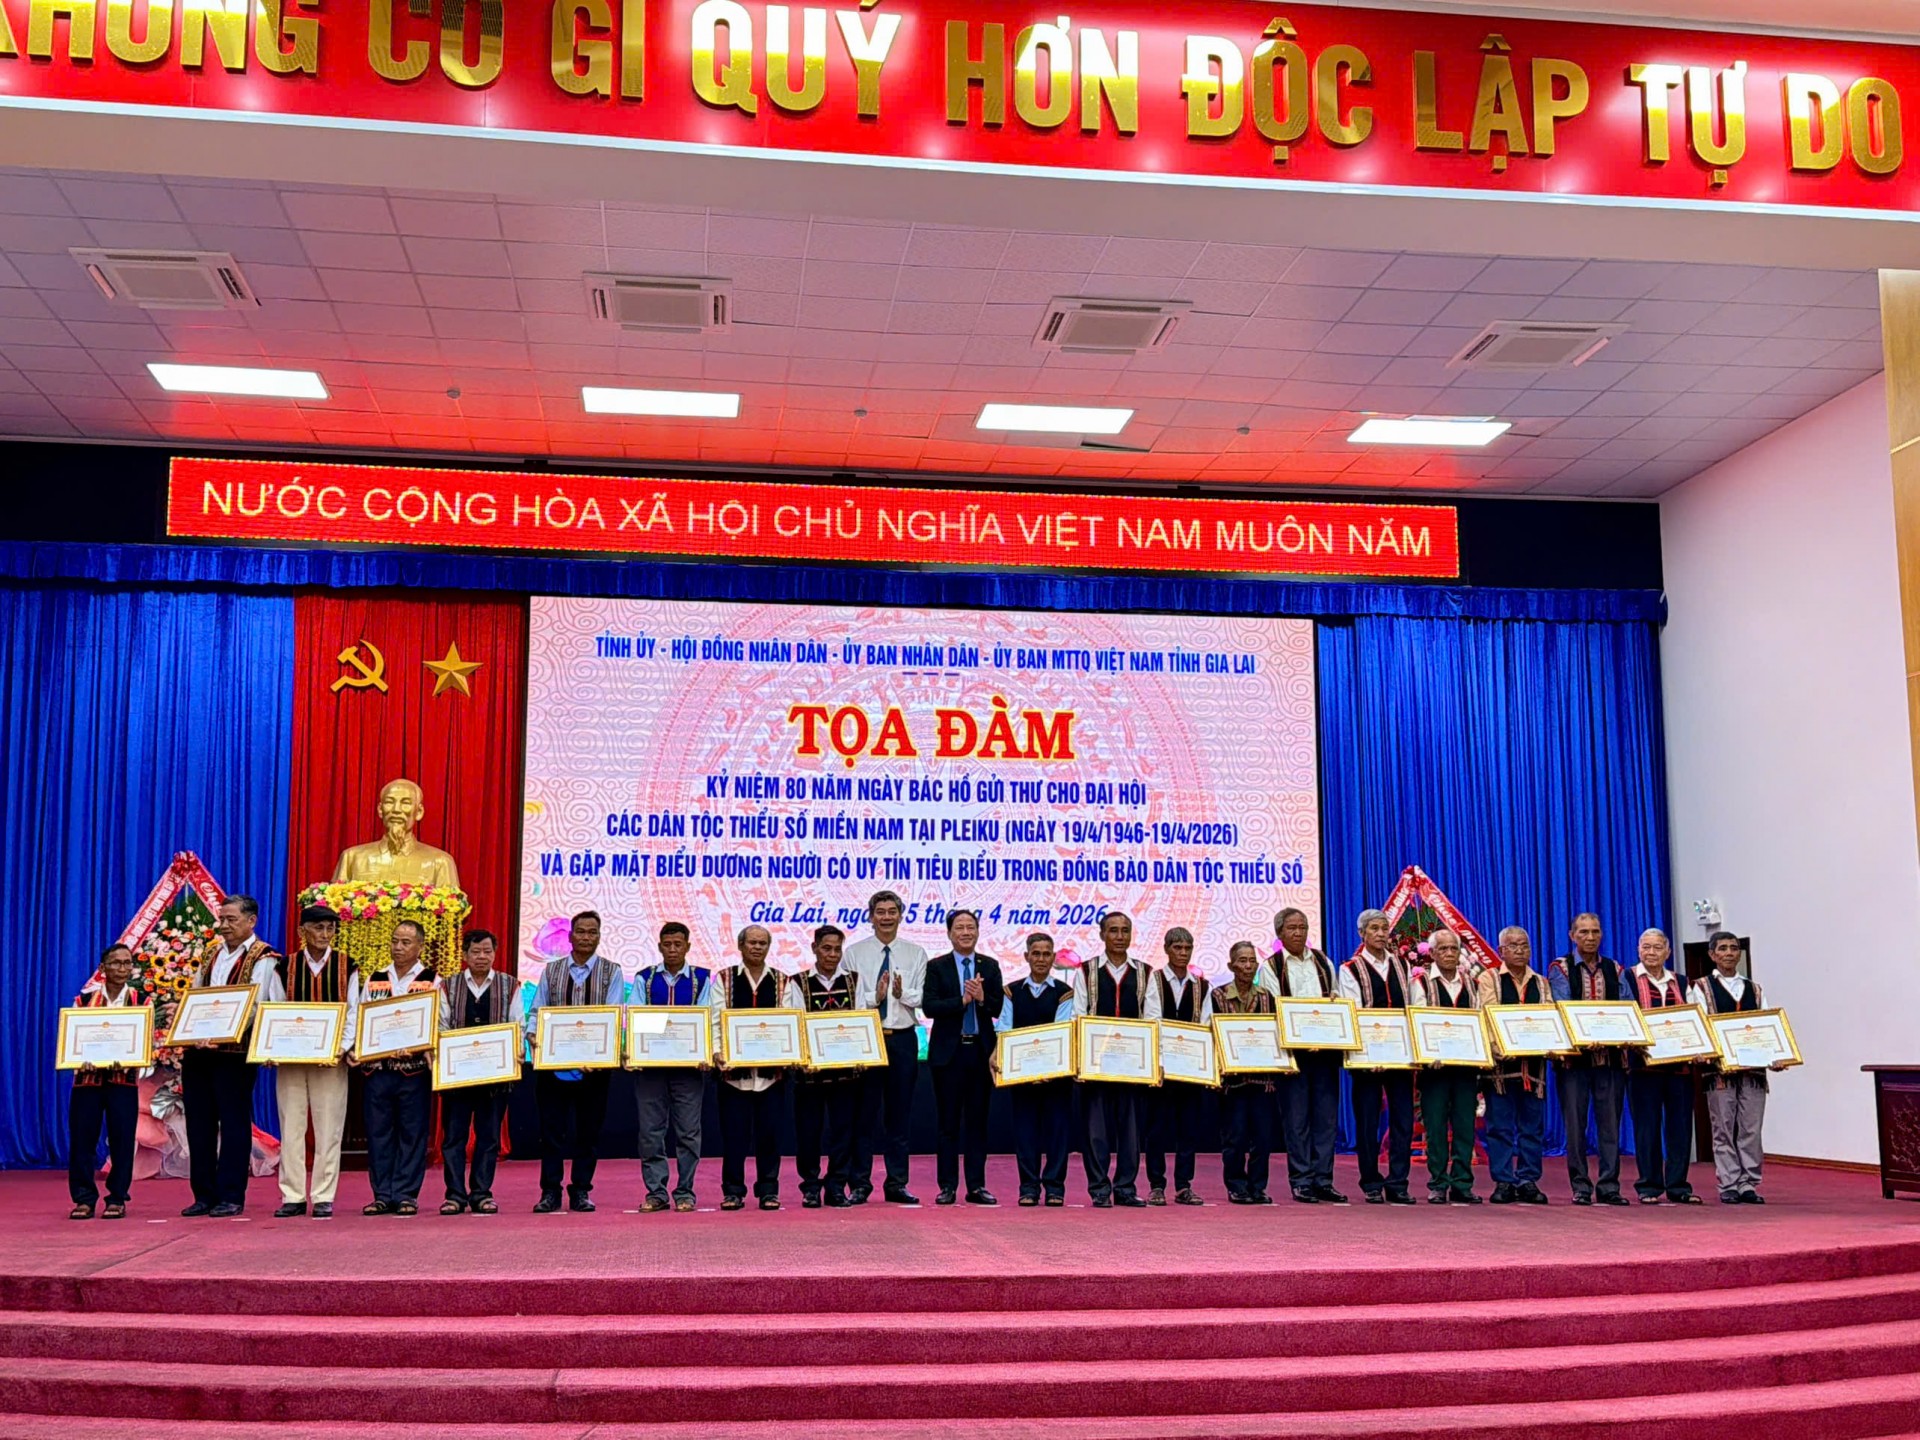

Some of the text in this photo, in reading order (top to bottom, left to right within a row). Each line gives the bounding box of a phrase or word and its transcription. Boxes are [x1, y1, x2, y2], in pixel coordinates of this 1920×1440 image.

[945, 16, 1138, 136] HƠN
[1181, 17, 1373, 163] ĐỘC
[1413, 33, 1589, 171] LẬP
[1630, 60, 1748, 187] TỰ
[1783, 72, 1903, 173] DO
[203, 477, 1430, 556] NƯỚC CỘNG HÒA XÃ HỘI CHỦ NGHĨA VIỆT NAM MUÔN NĂM
[596, 631, 631, 658] TỈNH
[637, 631, 655, 659] ỦY
[671, 635, 697, 664] HỘI
[702, 633, 743, 662] ĐỒNG
[749, 638, 791, 663] NHÂN
[797, 640, 827, 663] DÂN
[843, 638, 861, 664] ỦY
[867, 645, 897, 665] BAN
[902, 642, 943, 667] NHÂN
[949, 643, 978, 667] DÂN
[994, 641, 1012, 668] ỦY
[1017, 648, 1046, 669] BAN
[1052, 650, 1090, 672] MTTQ
[1095, 647, 1125, 675] VIỆT
[1130, 651, 1163, 672] NAM
[1168, 647, 1200, 673] TỈNH
[1206, 654, 1229, 673] GIA
[1234, 654, 1255, 674] LAI
[789, 695, 1075, 768] TỌA ĐÀM
[707, 769, 1146, 808] KỶ NIỆM 80 NĂM NGÀY BÁC HỒ GỬI THƯ CHO ĐẠI HỘI
[607, 807, 1238, 847] CÁC DÂN TỘC THIỂU SỐ MIỀN NAM TẠI PLEIKU (NGÀY 19/4/1946-19/4/2026)
[541, 846, 1303, 888] VÀ GẶP MẶT BIỂU DƯƠNG NGƯỜI CÓ UY TÍN TIÊU BIỂU TRONG ĐỒNG BÀO DÂN TỘC THIỂU SỐ
[750, 902, 784, 923] Gia
[790, 902, 827, 926] Lai,
[900, 903, 920, 924] 5
[989, 903, 1002, 924] 4
[1007, 904, 1051, 925] năm
[1056, 904, 1109, 925] 2026
